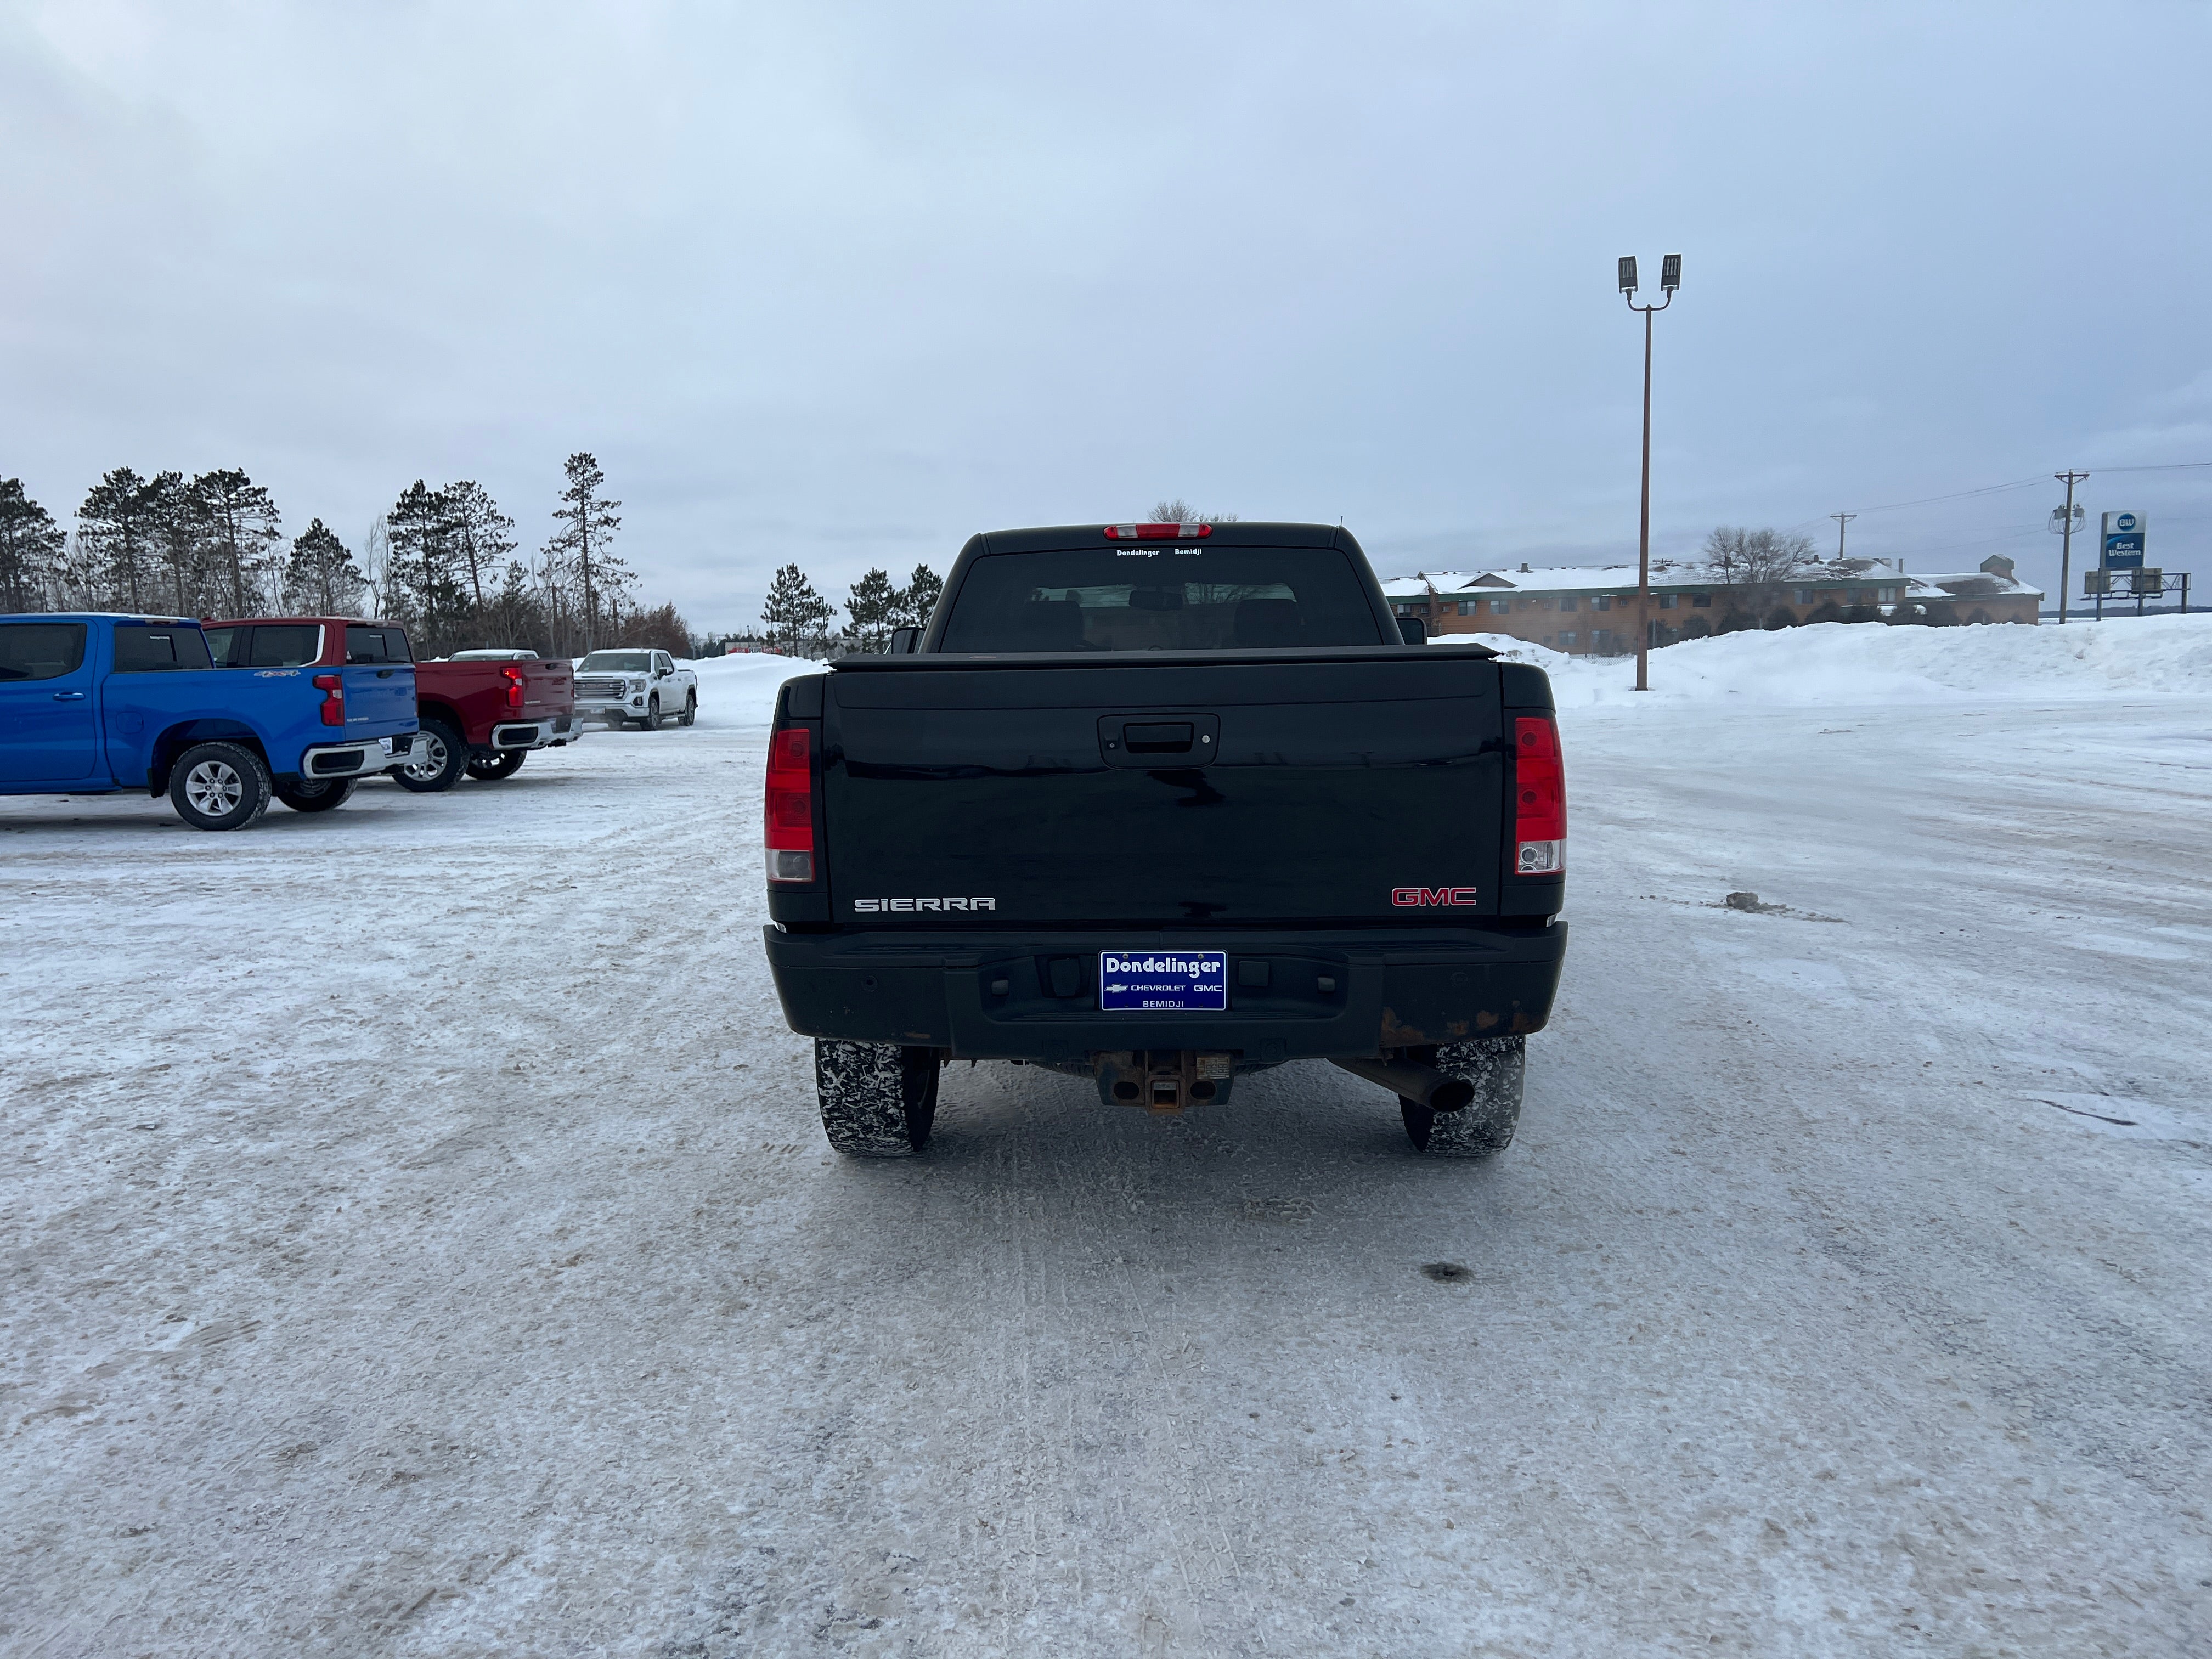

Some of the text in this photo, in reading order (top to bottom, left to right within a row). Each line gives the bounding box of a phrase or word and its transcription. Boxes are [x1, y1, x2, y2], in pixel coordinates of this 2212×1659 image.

[1116, 549, 1160, 557] Dondelinger
[854, 897, 996, 912] SIERRA
[1391, 887, 1477, 906] GMC
[1105, 957, 1221, 979] Dondelinger
